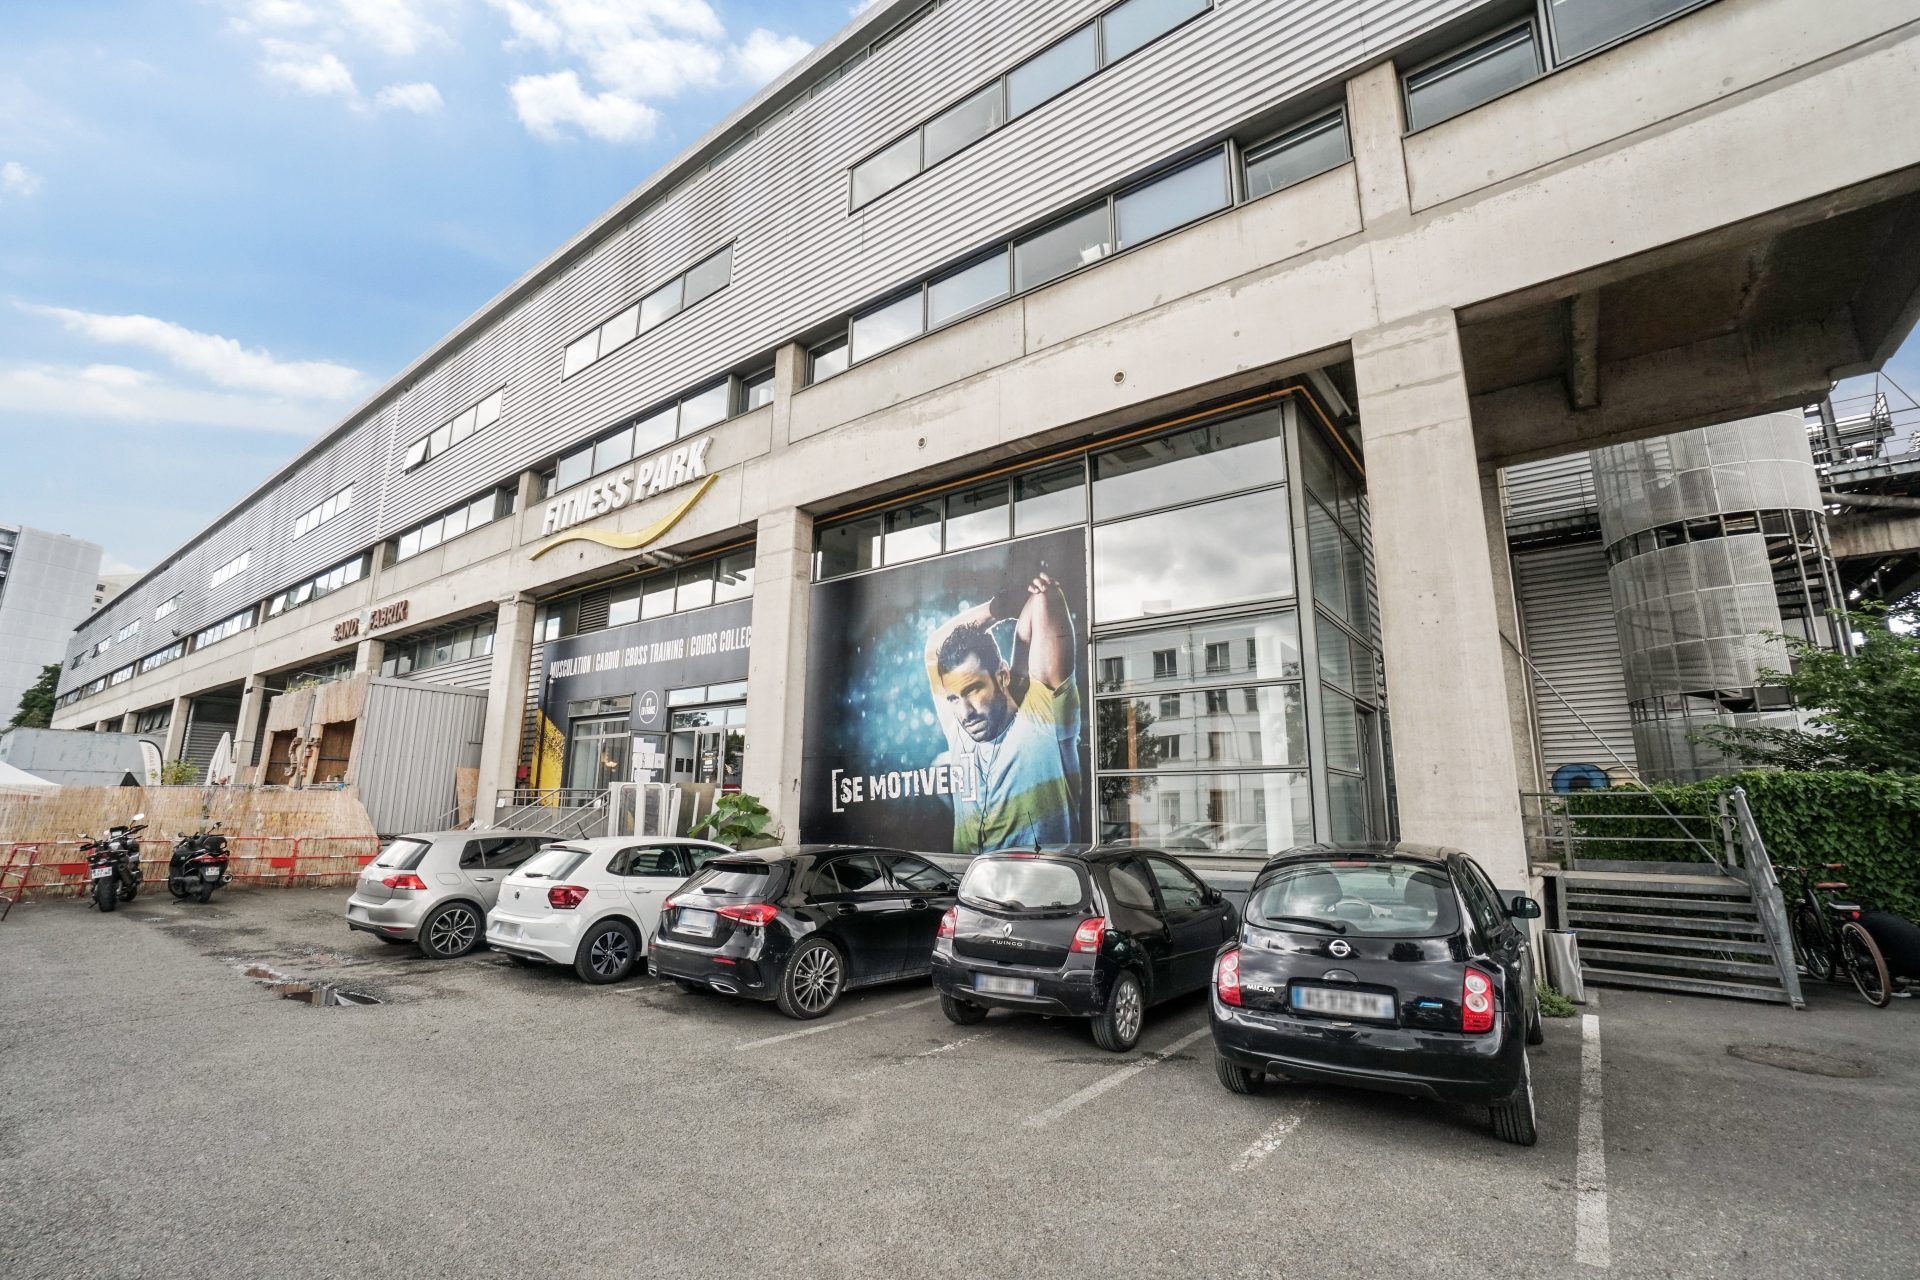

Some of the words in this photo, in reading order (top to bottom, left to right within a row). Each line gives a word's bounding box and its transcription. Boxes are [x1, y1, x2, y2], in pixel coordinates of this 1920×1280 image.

[541, 469, 634, 537] FITNESS
[634, 436, 714, 504] PARK
[332, 617, 359, 642] SAND
[369, 599, 409, 631] FABRIK
[549, 655, 592, 679] MUSCULATION
[595, 649, 620, 672] CARDIO
[624, 645, 648, 667] CROSS
[650, 638, 684, 664] TRAINING
[690, 631, 718, 657] COURS
[991, 939, 1023, 947] TWINGO
[1246, 984, 1276, 994] MICRA
